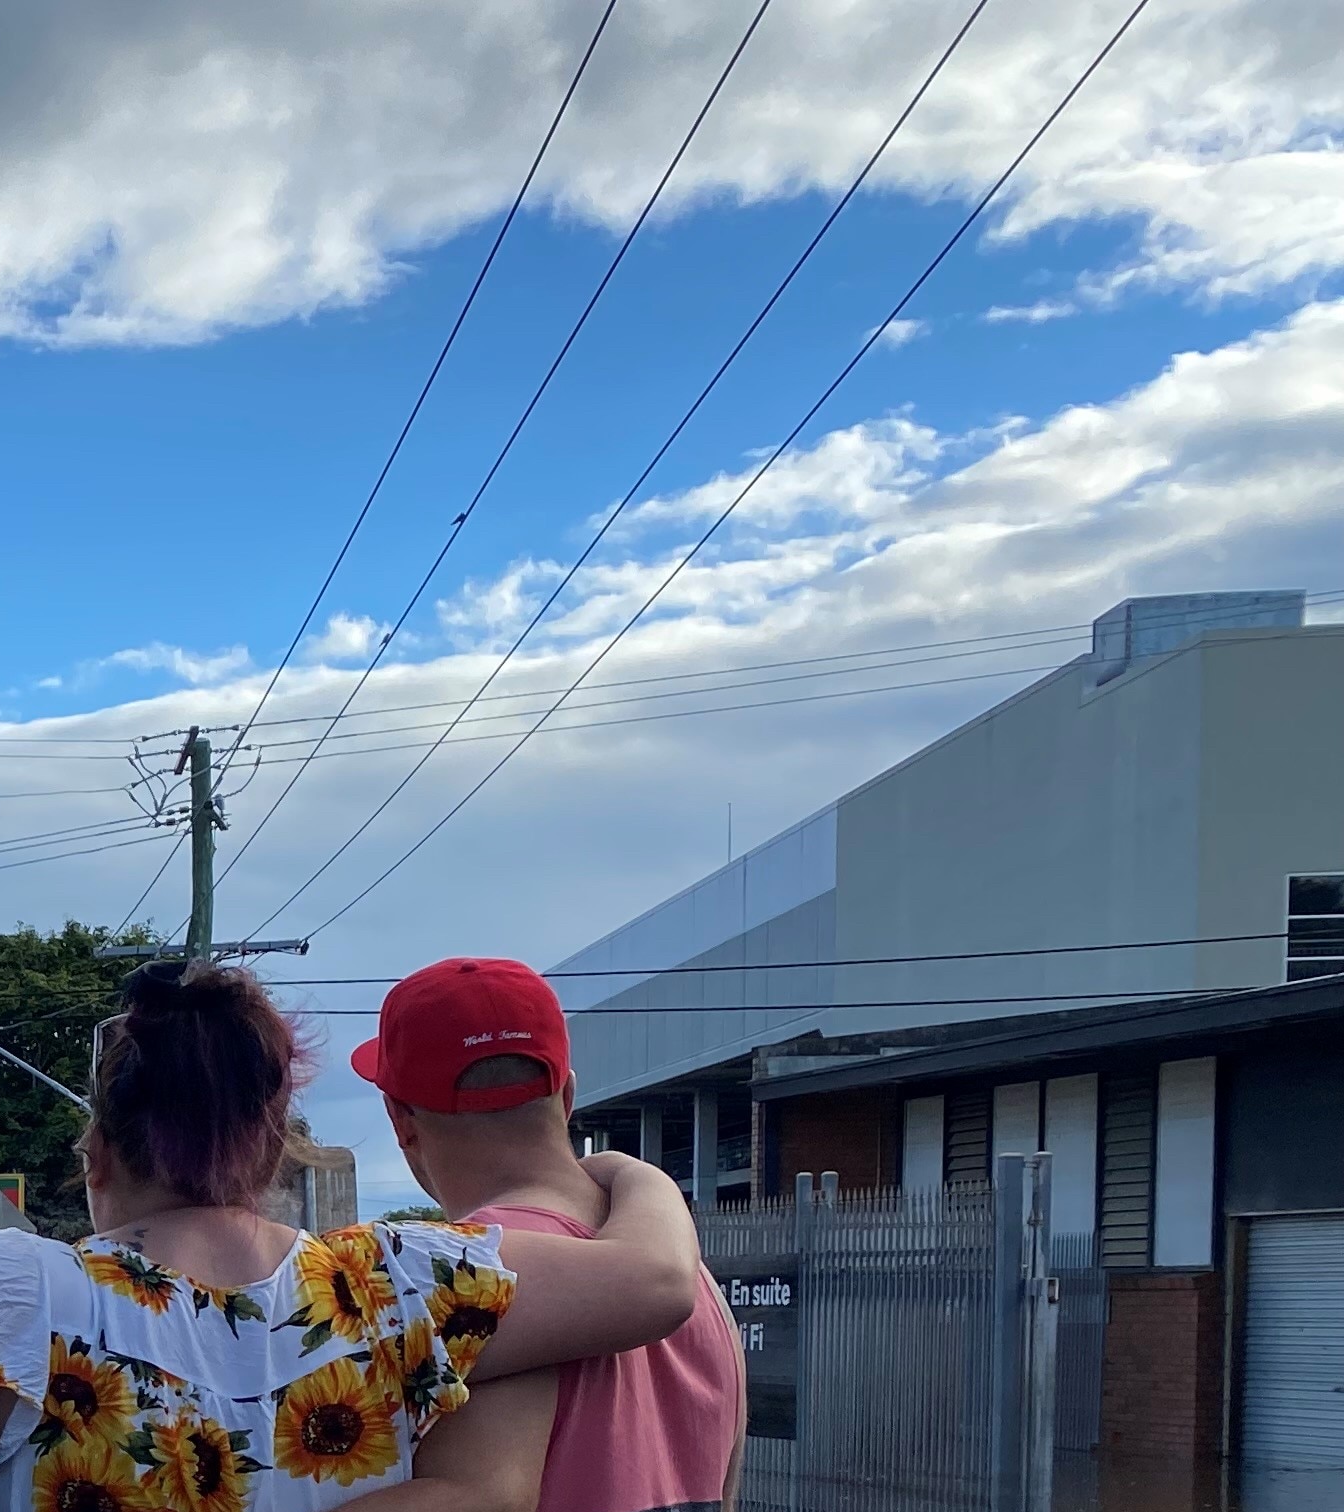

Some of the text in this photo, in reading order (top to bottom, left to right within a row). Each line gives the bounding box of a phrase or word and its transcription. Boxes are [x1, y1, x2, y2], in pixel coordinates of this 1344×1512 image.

[463, 1030, 532, 1048] World Famous
[731, 1279, 750, 1306] En
[752, 1276, 791, 1306] suite
[750, 1322, 764, 1351] Fi
